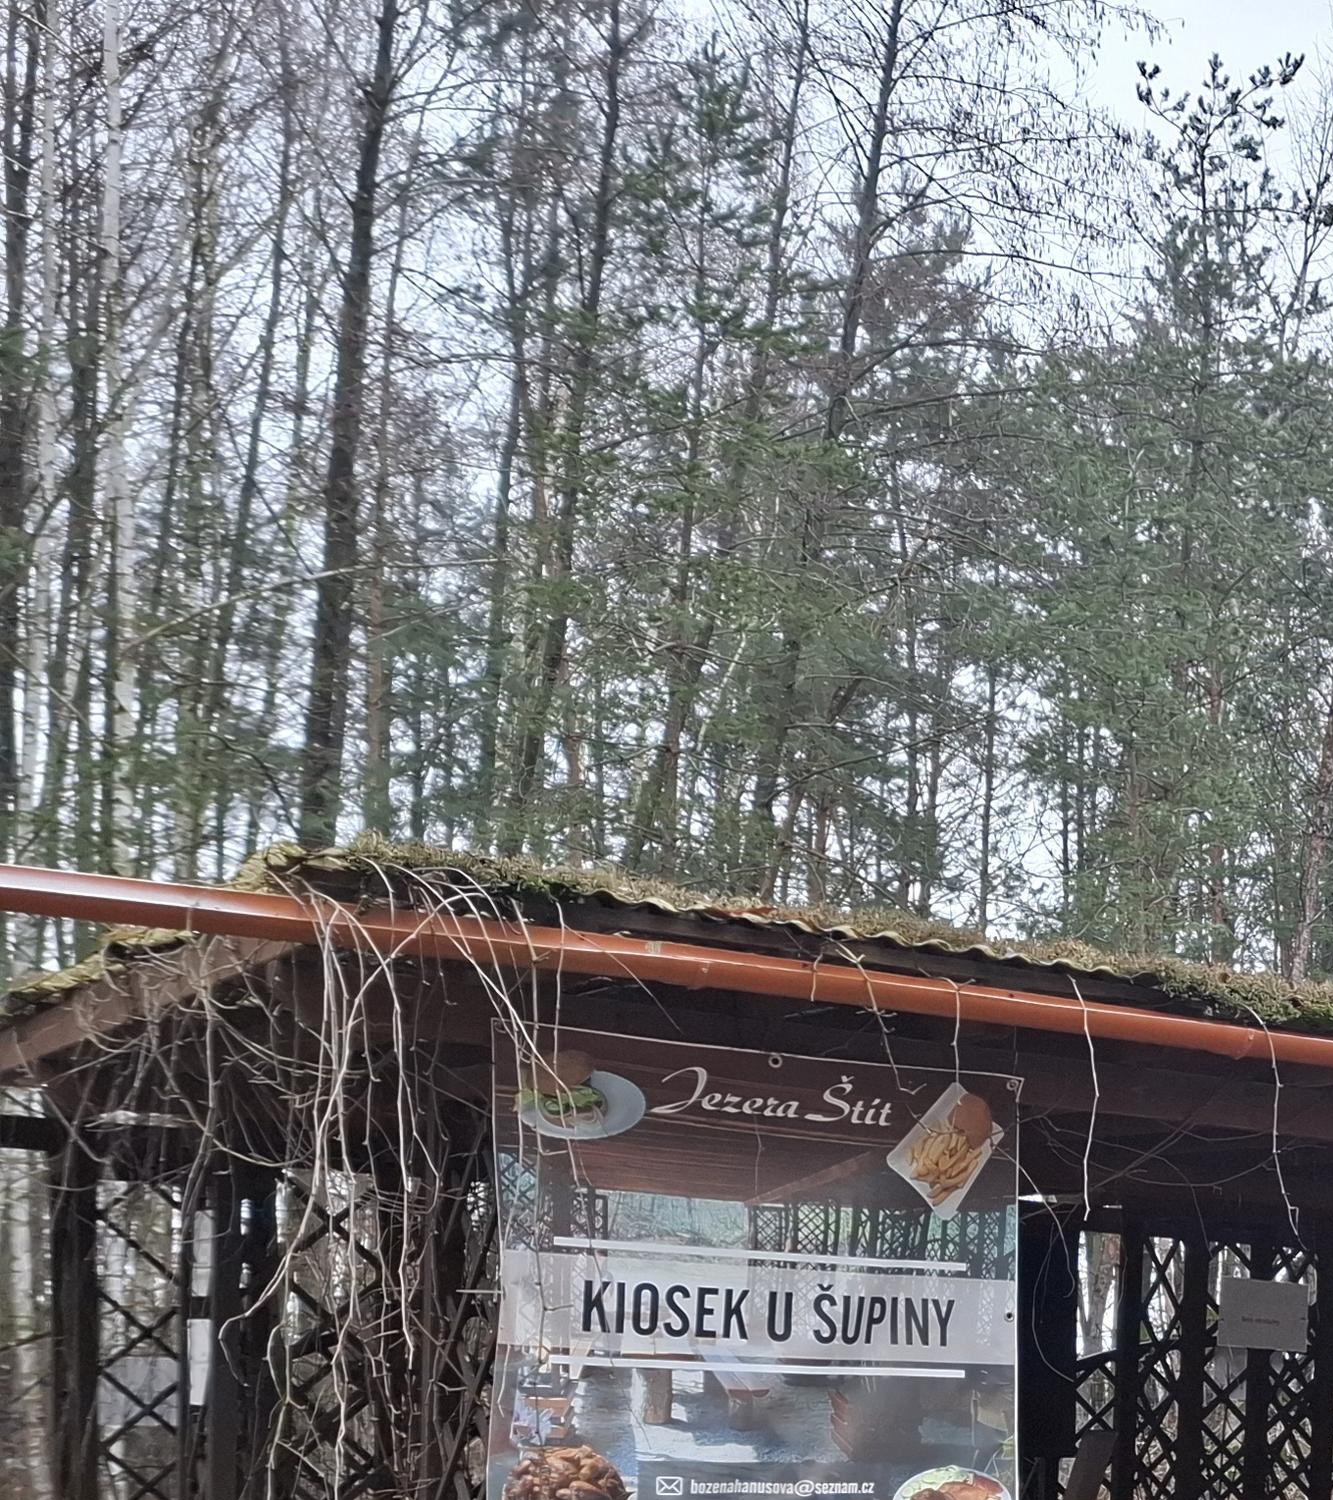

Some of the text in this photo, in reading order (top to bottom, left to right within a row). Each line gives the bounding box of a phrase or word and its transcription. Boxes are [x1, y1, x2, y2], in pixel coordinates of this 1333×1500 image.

[650, 1067, 892, 1126] Jezera Štít
[581, 1280, 955, 1347] KIOSEK U ŠUPINY
[690, 1479, 874, 1497] bozenahanusova@seznam.cz
